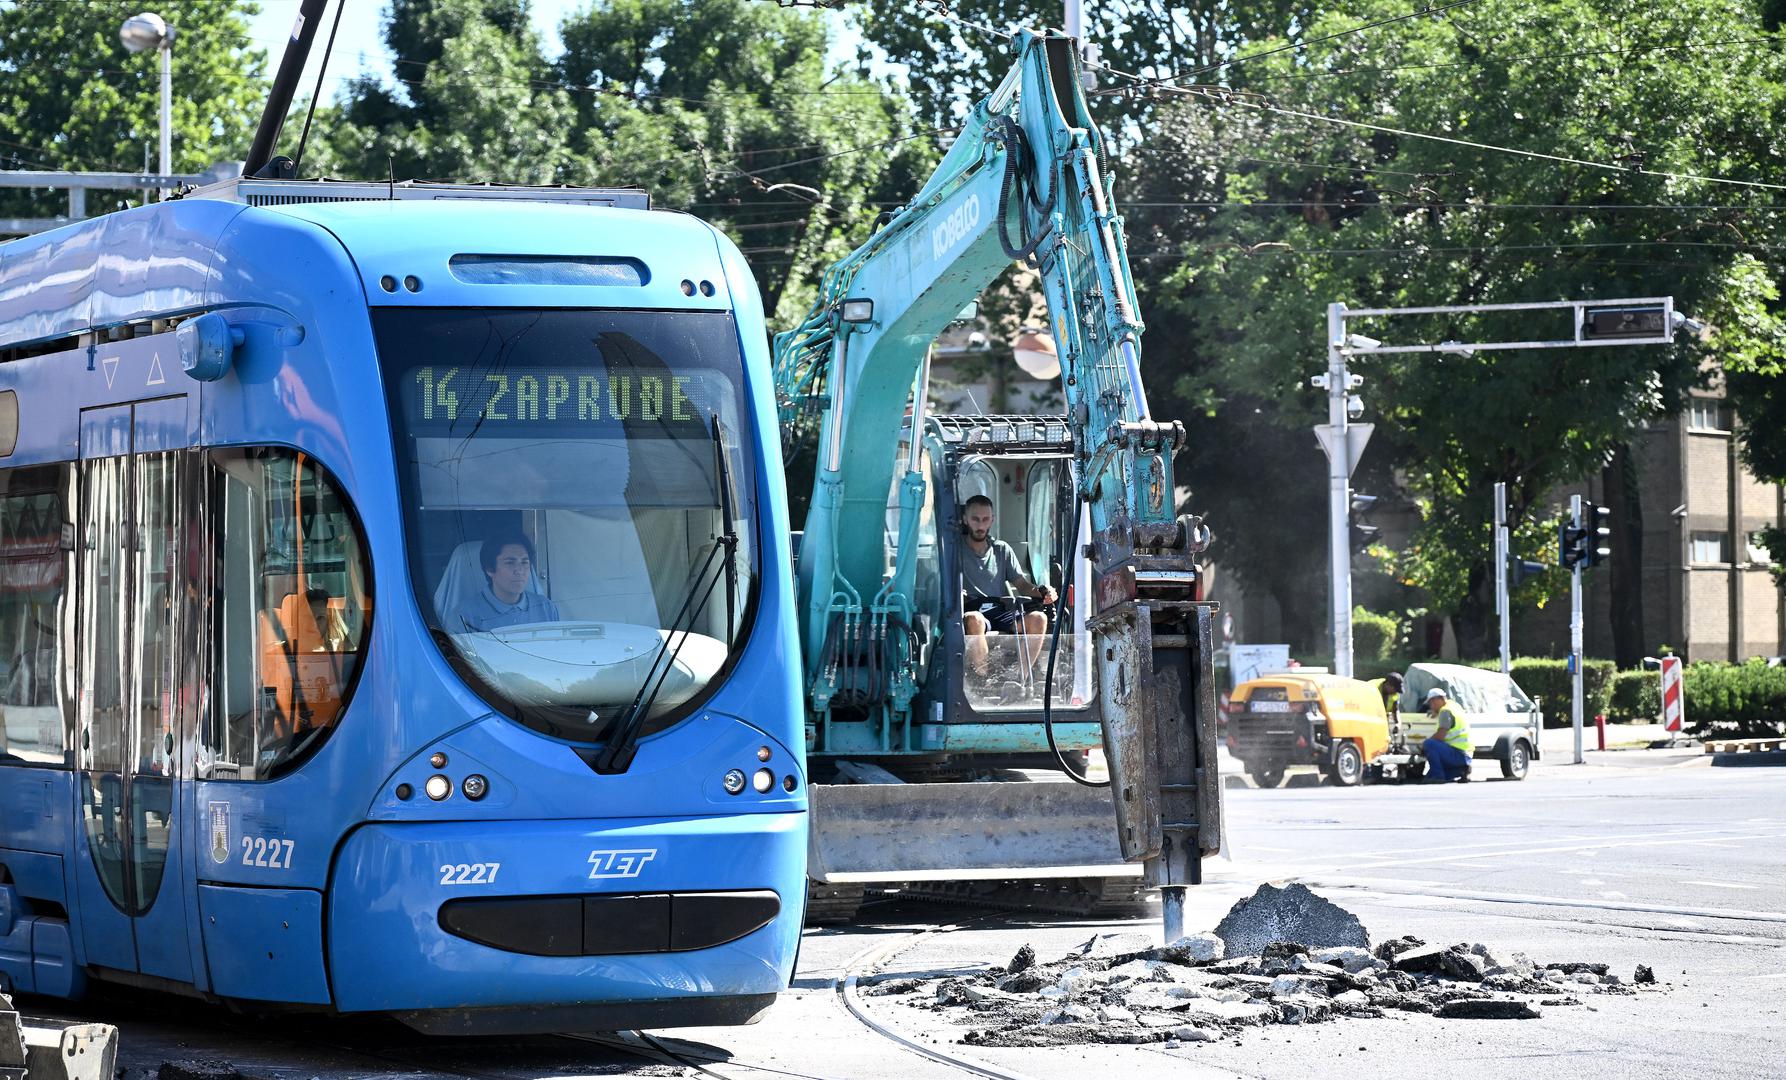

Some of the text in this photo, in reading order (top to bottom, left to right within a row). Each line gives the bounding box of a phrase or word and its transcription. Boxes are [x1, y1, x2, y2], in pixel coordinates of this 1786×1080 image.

[932, 194, 979, 260] KOBELCO
[416, 367, 458, 419] 14
[242, 836, 294, 869] 2227
[587, 849, 657, 879] ZET
[440, 863, 500, 885] 2227
